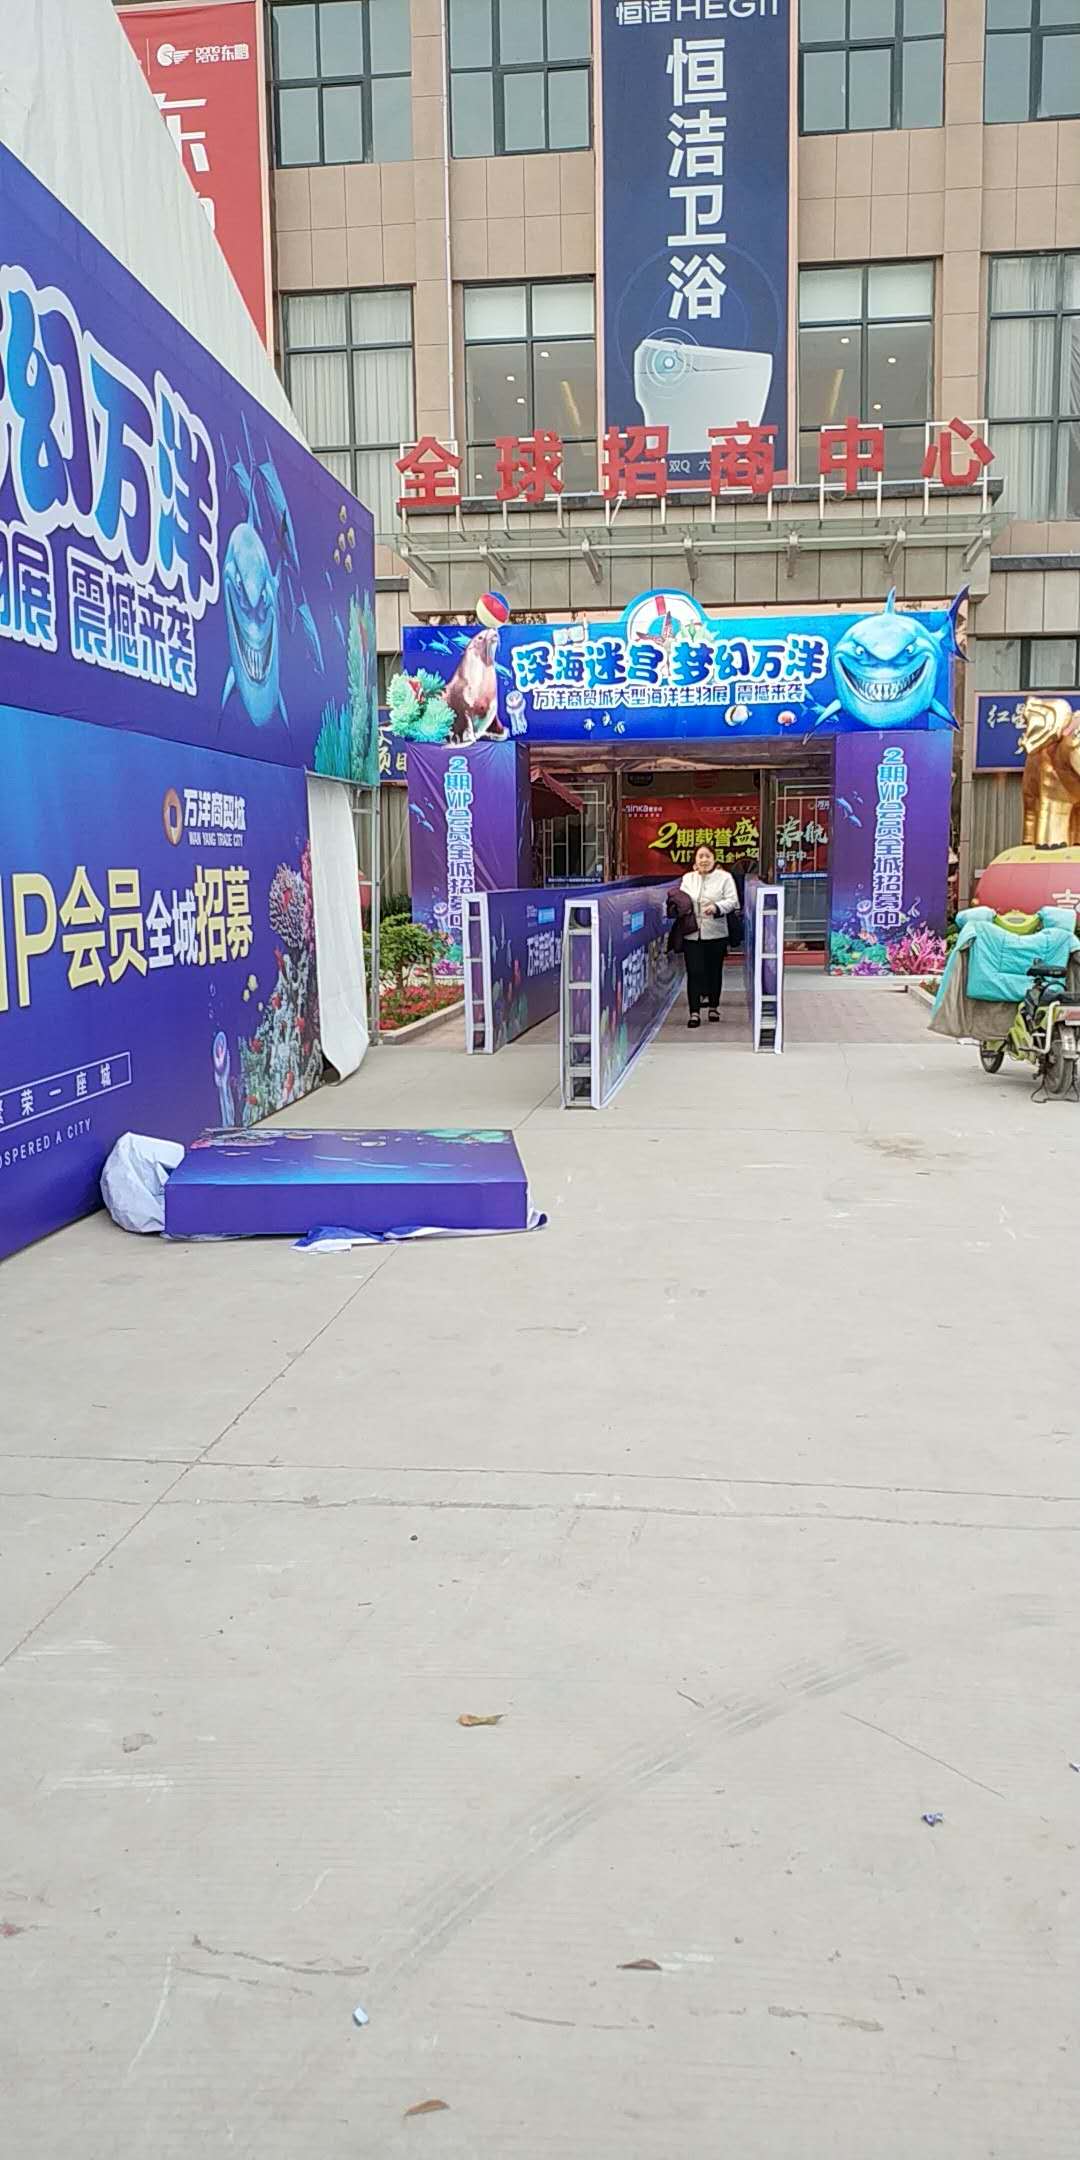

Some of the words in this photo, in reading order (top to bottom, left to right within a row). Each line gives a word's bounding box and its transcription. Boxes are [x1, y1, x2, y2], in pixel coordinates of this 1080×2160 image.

[616, 0, 671, 25] 恒洁
[666, 38, 727, 320] 恒洁卫浴
[0, 265, 219, 620] 幻万洋
[396, 417, 996, 505] 全球招商中心
[68, 546, 197, 697] 震撼来袭
[511, 638, 664, 692] 深海迷宫
[666, 634, 828, 688] 梦幻万洋
[183, 788, 247, 831] 万洋商贸城
[0, 1062, 112, 1125] 荣一座城
[56, 1130, 63, 1145] A
[67, 1117, 92, 1139] CITY
